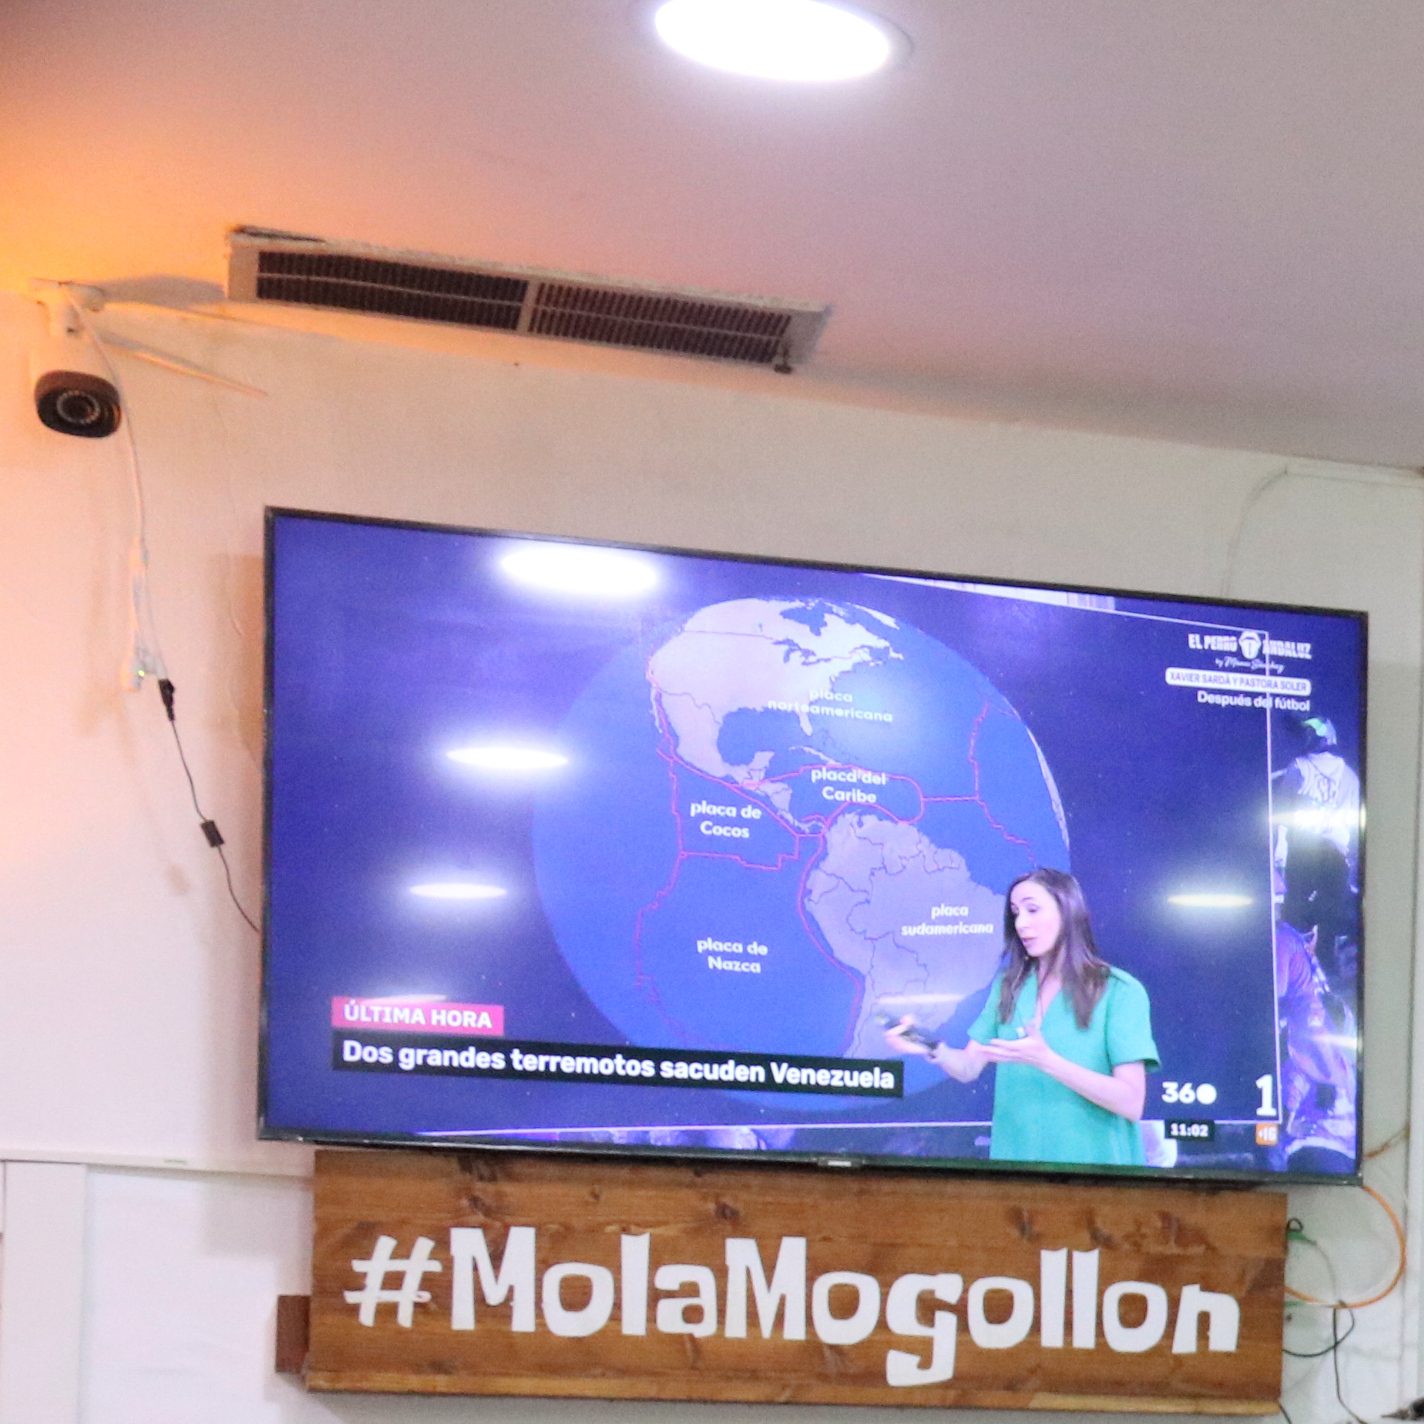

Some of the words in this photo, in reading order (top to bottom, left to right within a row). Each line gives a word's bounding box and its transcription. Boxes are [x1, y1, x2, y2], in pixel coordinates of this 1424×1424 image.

[1197, 690, 1252, 708] Después
[1275, 696, 1311, 712] fútbol
[811, 767, 858, 784] placa
[861, 772, 888, 786] del
[821, 786, 878, 804] Caribe
[690, 799, 738, 818] placa
[740, 804, 763, 820] de
[700, 820, 751, 839] Cocos
[930, 903, 970, 920] placa
[900, 920, 995, 937] sudamericana
[696, 936, 744, 954] placa
[746, 941, 769, 957] de
[707, 955, 762, 974] Nazca
[343, 999, 427, 1026] ÚLTIMA
[430, 1008, 493, 1029] HORA
[342, 1039, 394, 1064] Dos
[398, 1046, 507, 1071] grandes
[510, 1048, 656, 1077] terremotos
[659, 1058, 766, 1083] sacuden
[770, 1061, 895, 1090] Venezuela
[1169, 1122, 1210, 1138] 11:02
[343, 1225, 1241, 1388] #MolaMogollon
